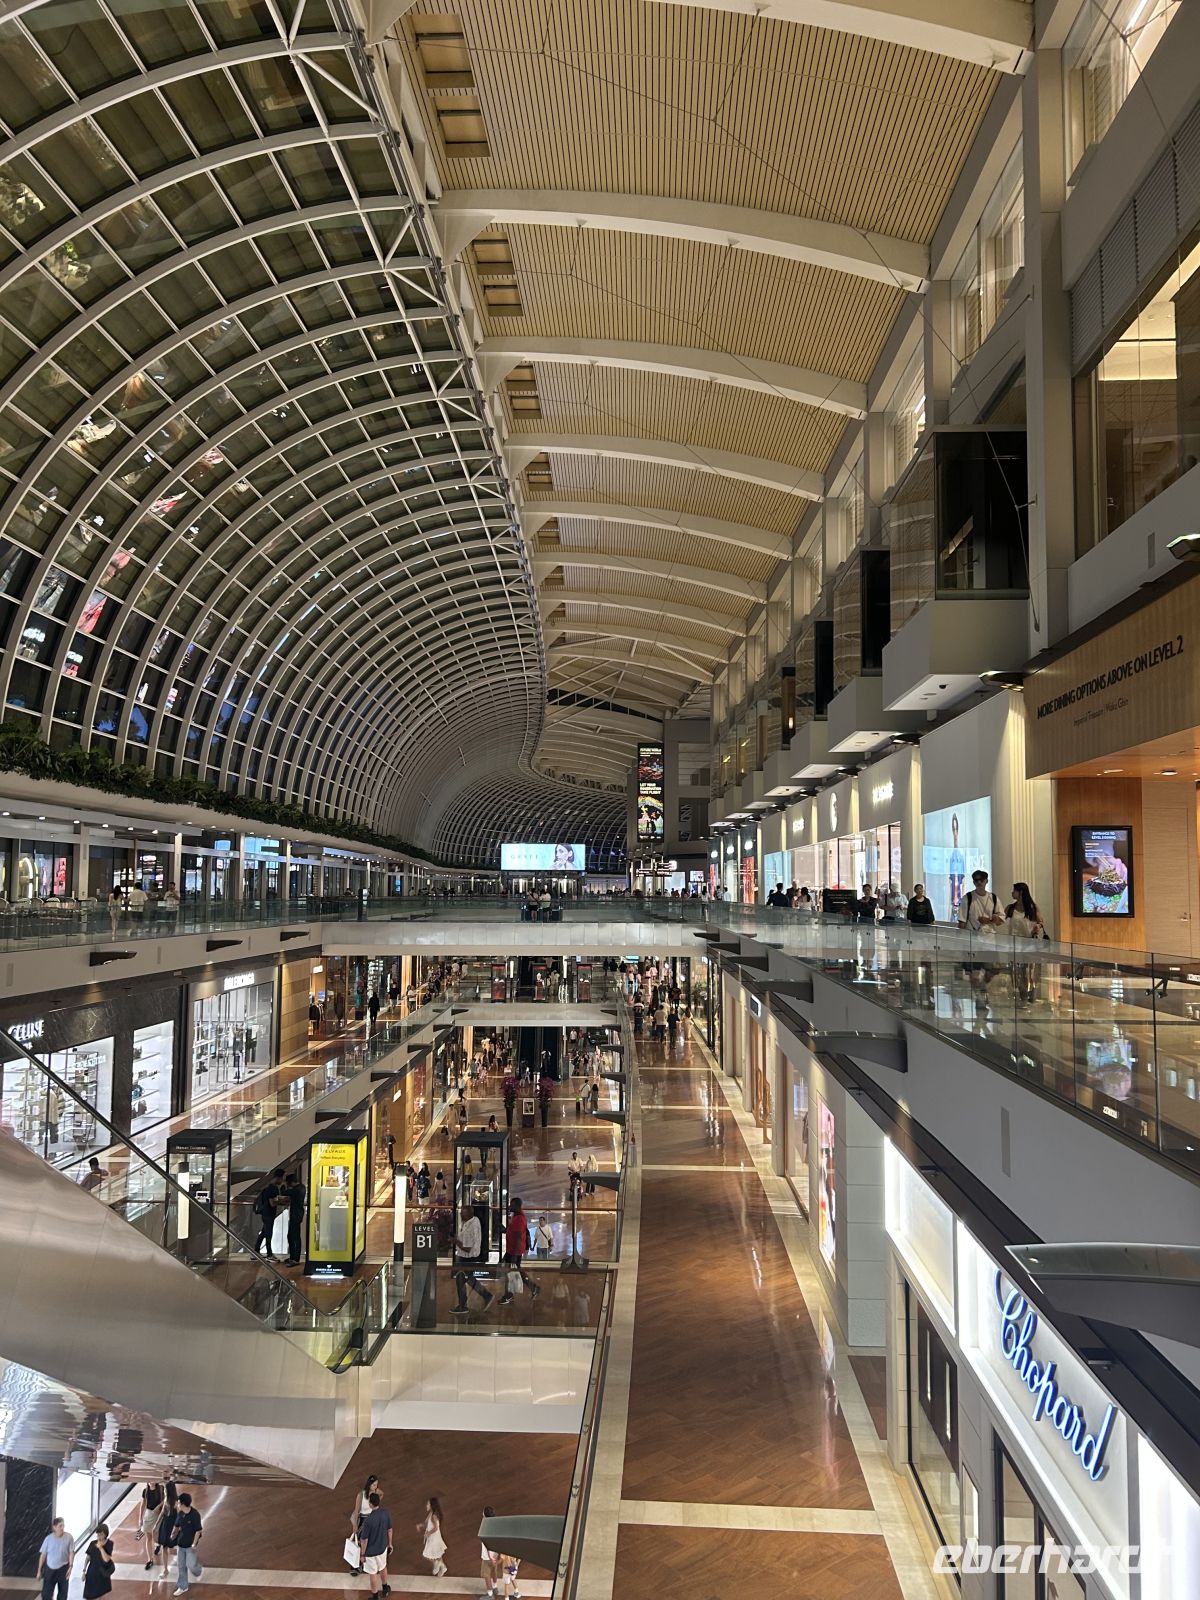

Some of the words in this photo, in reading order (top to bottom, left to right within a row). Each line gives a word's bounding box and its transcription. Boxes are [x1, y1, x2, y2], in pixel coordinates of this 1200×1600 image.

[1037, 700, 1054, 720] MORE
[1053, 689, 1075, 711] DINING
[1076, 674, 1106, 700] OPTIONS
[1106, 660, 1133, 687] ABOVE
[1134, 653, 1148, 674] ON
[1148, 641, 1176, 668] LEVEL
[1176, 635, 1184, 655] 2
[416, 1234, 432, 1248] B1
[993, 1267, 1118, 1482] Chopard
